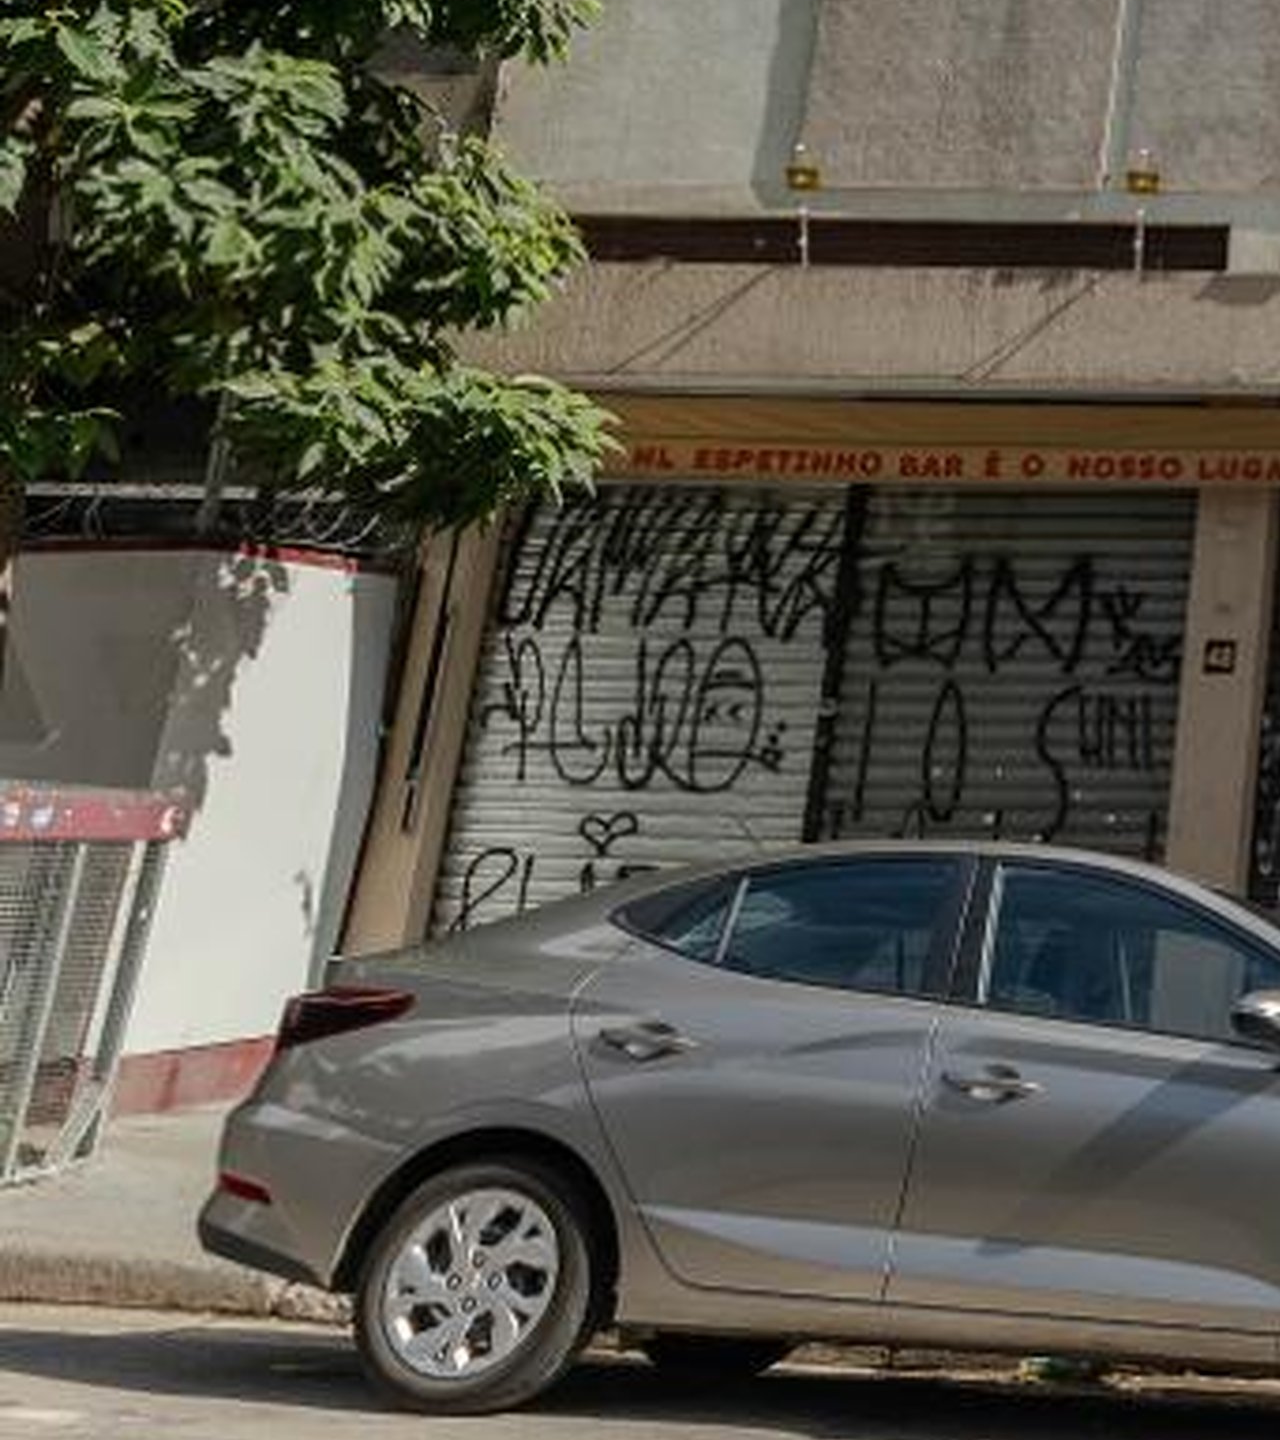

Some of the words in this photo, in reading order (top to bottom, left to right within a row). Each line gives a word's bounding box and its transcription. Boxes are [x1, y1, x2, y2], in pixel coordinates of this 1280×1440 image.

[694, 449, 882, 476] ESPETINHO
[900, 453, 962, 478] BAR
[1022, 454, 1045, 478] O
[1068, 455, 1182, 480] NOSSO
